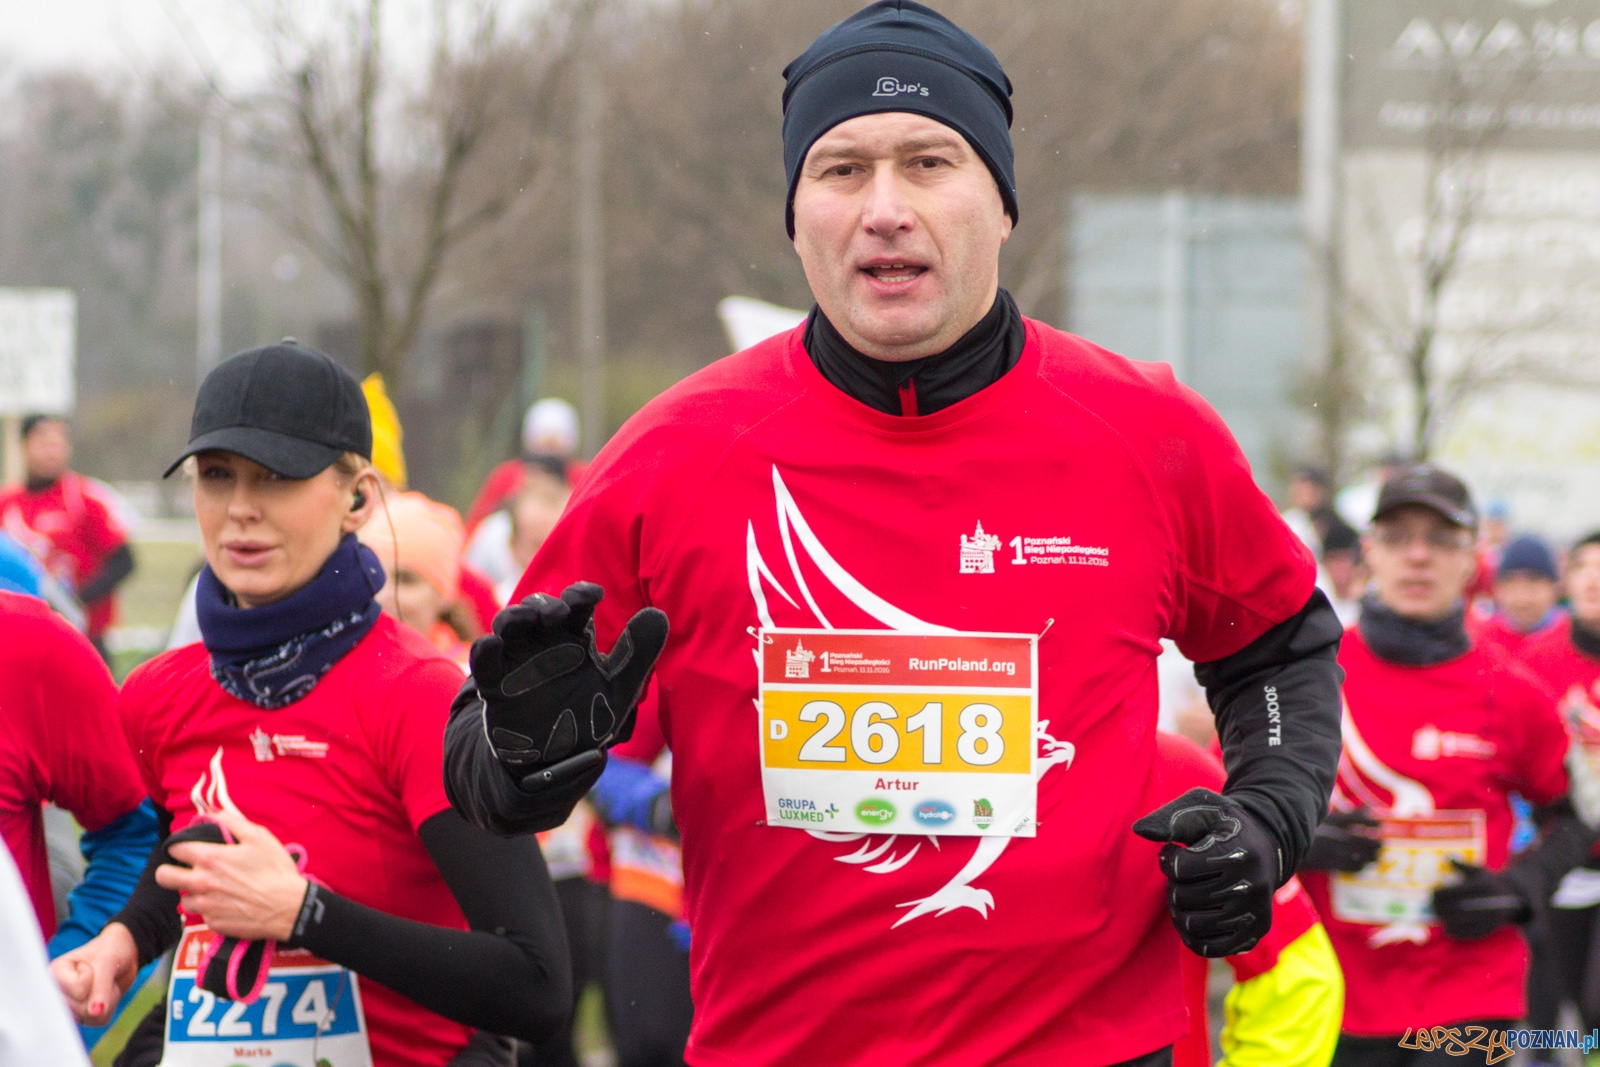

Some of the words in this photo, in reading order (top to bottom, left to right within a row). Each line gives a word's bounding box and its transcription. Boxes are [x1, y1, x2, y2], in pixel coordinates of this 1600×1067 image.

[1009, 535, 1027, 565] 1
[1024, 536, 1071, 545] Poznański
[1024, 545, 1044, 555] Bieg
[1046, 545, 1109, 556] Niepodległości
[1068, 556, 1109, 567] 11.11.2016
[819, 651, 832, 673] 1
[909, 657, 1016, 676] RunPoland.org
[769, 719, 789, 740] D
[798, 700, 1005, 766] 2618
[874, 778, 920, 791] Artur
[778, 798, 816, 811] GRUPA
[779, 809, 824, 823] LUXMED
[861, 809, 893, 820] energy
[173, 1000, 184, 1020] E
[187, 979, 336, 1037] 2274
[234, 1047, 272, 1058] Marta
